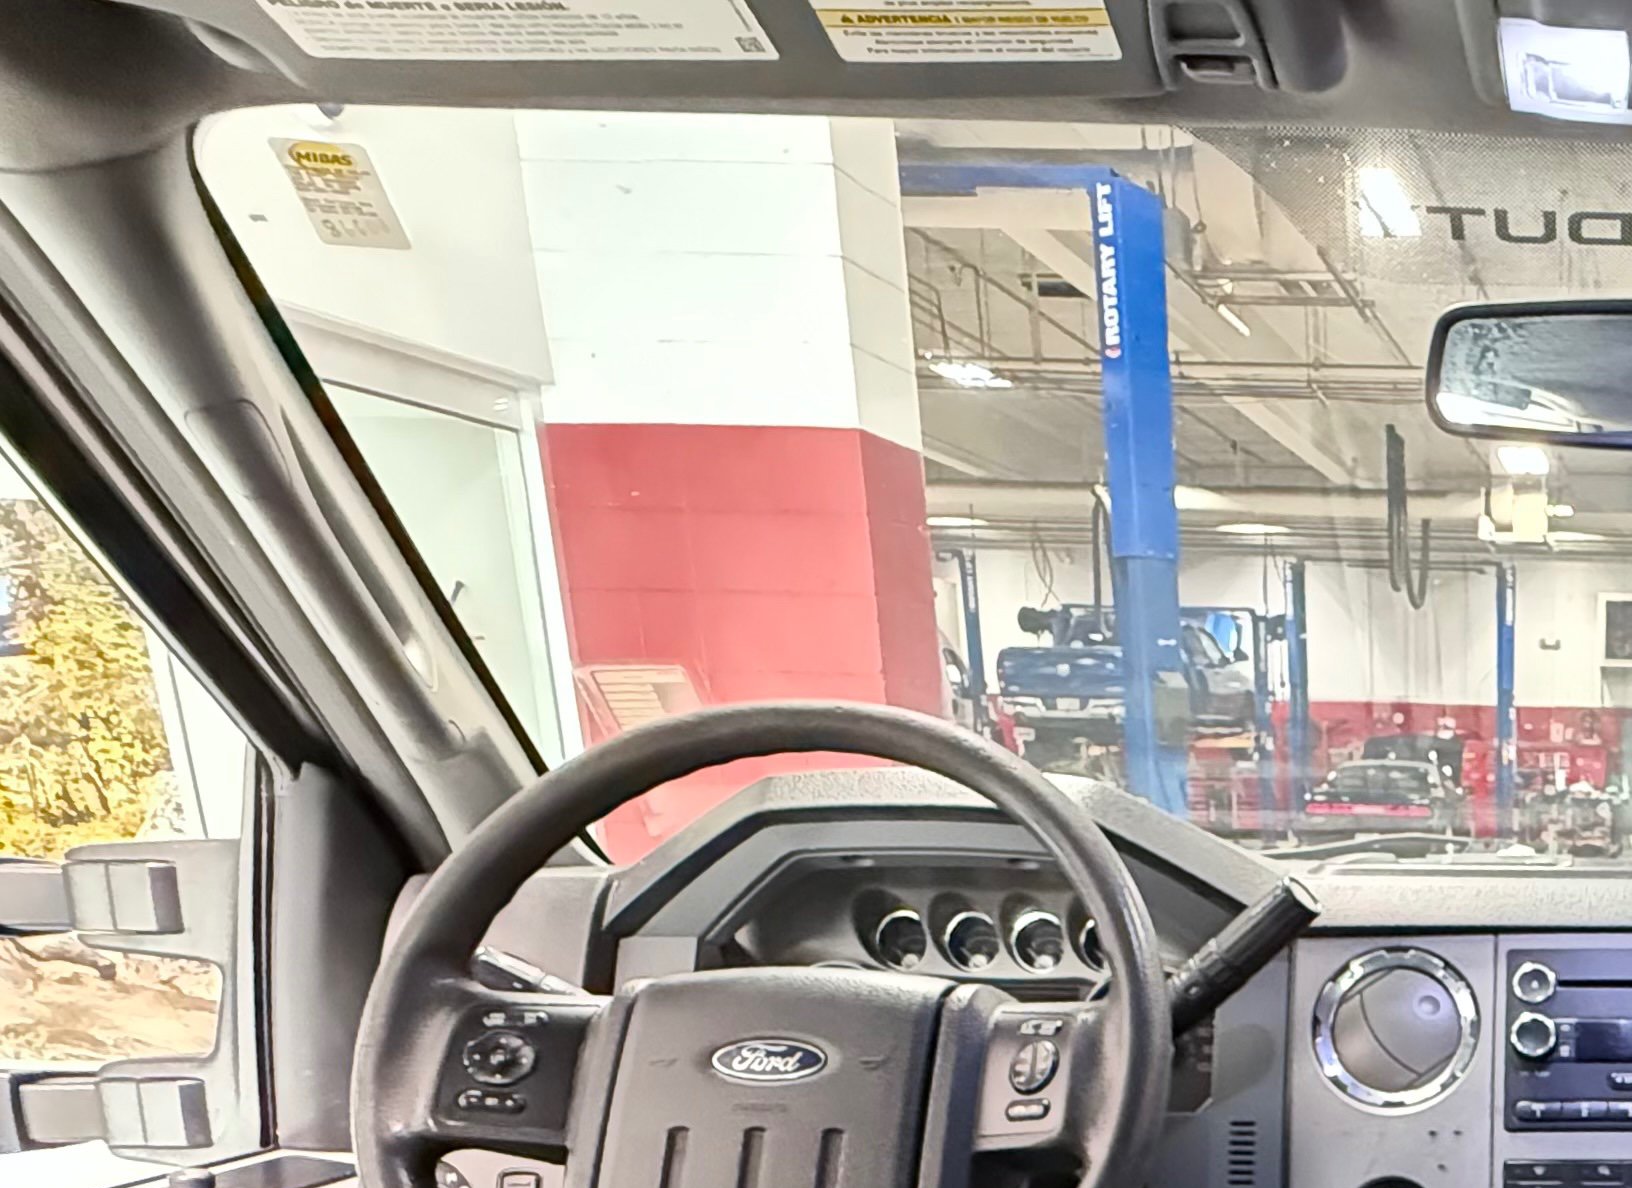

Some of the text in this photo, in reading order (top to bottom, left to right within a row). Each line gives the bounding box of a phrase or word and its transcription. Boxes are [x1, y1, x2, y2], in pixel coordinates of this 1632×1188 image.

[296, 151, 353, 167] MIDAS
[1096, 182, 1121, 346] ROTARY LIFT
[731, 1043, 805, 1072] Ford
